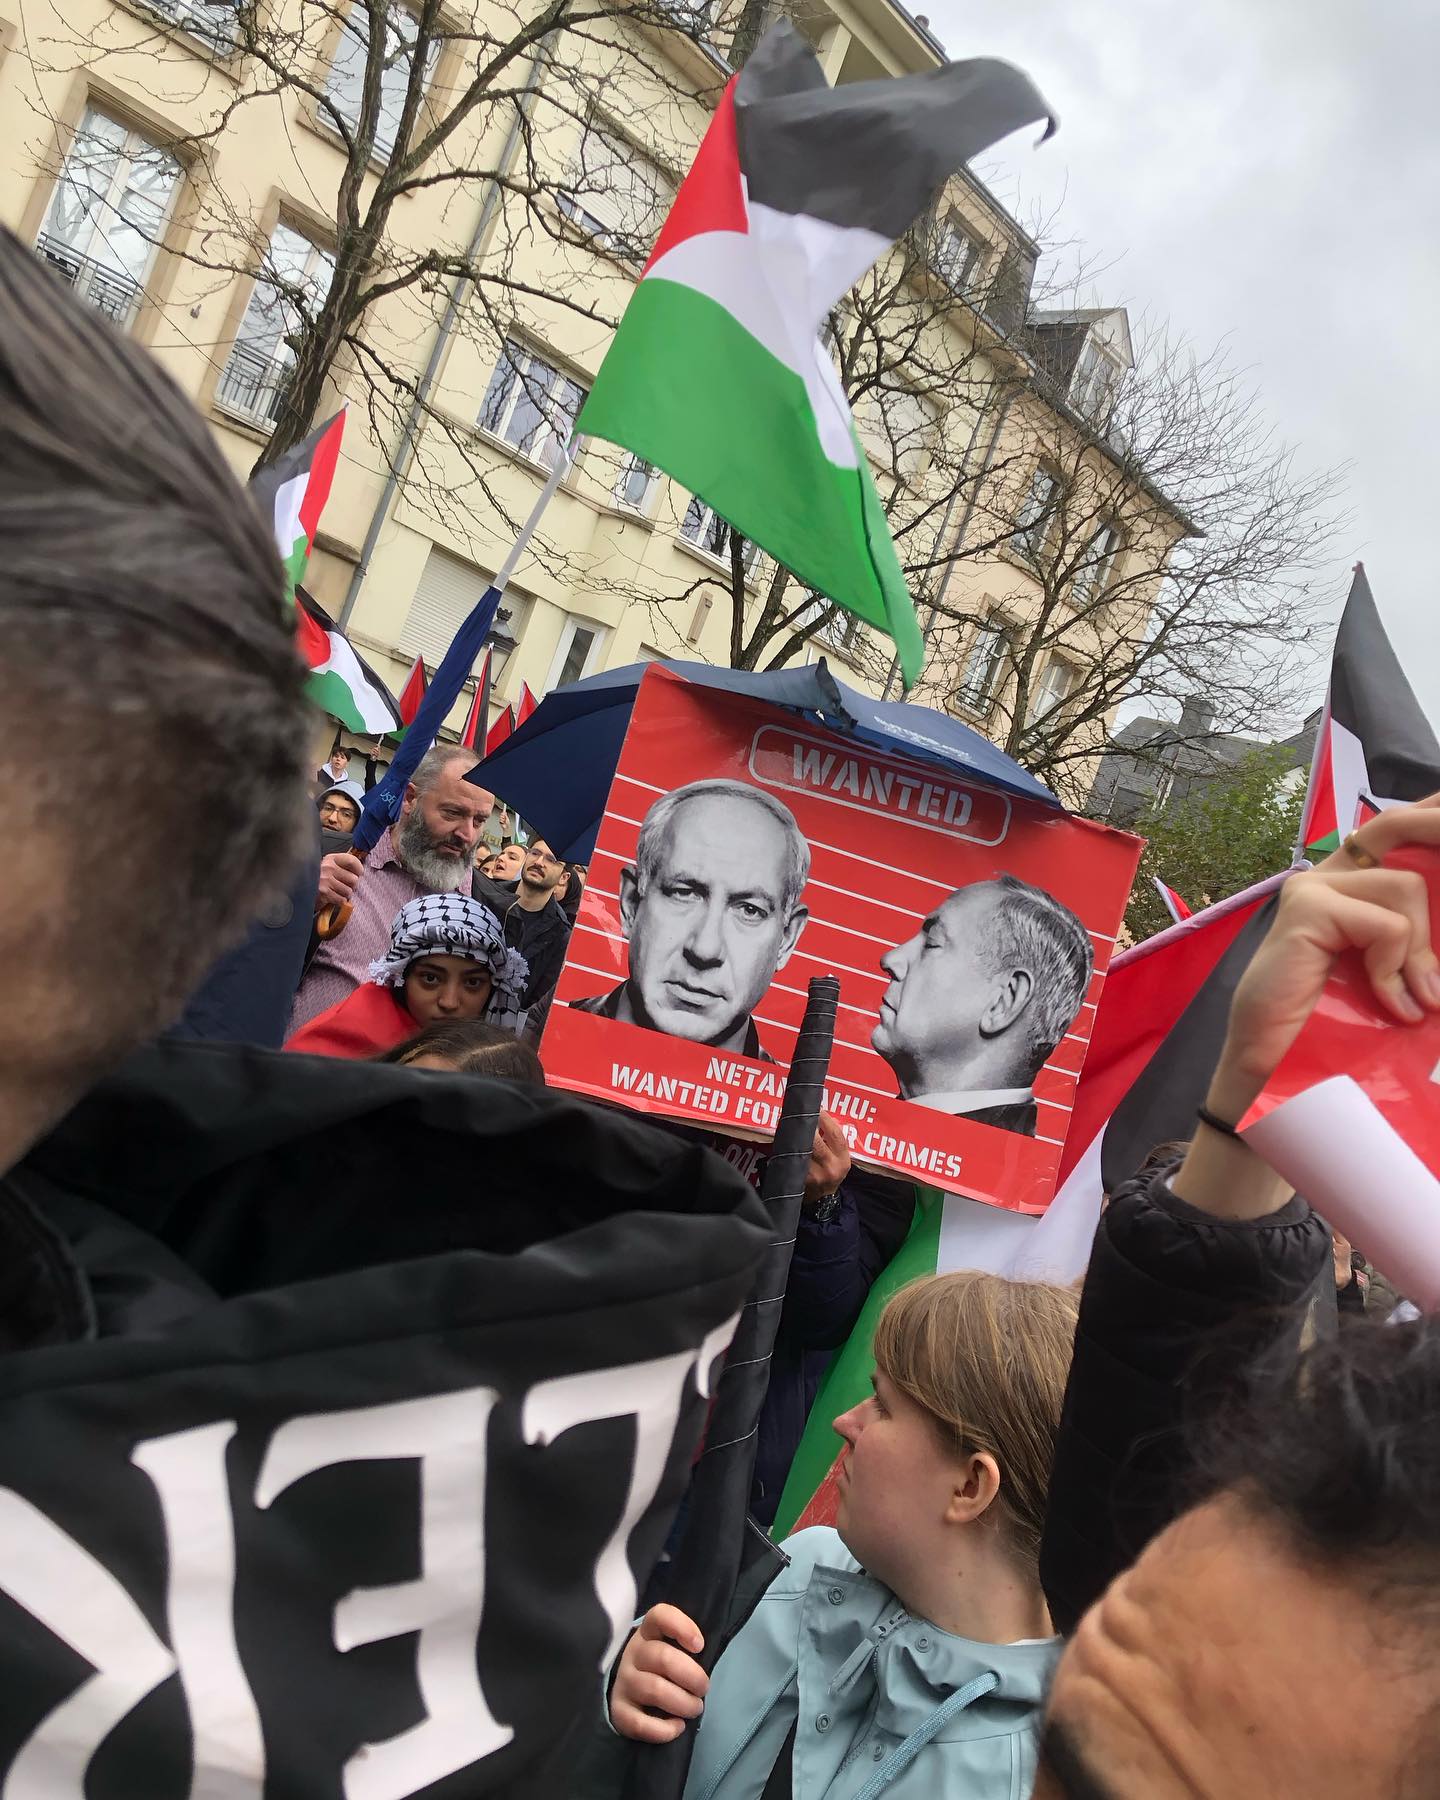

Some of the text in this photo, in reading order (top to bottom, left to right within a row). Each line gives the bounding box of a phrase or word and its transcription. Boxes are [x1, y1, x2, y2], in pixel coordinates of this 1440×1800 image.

[793, 744, 973, 827] WANTED
[611, 1063, 729, 1115] WANTED
[863, 1132, 963, 1178] CRIMES
[706, 1057, 877, 1123] NETAAHU:
